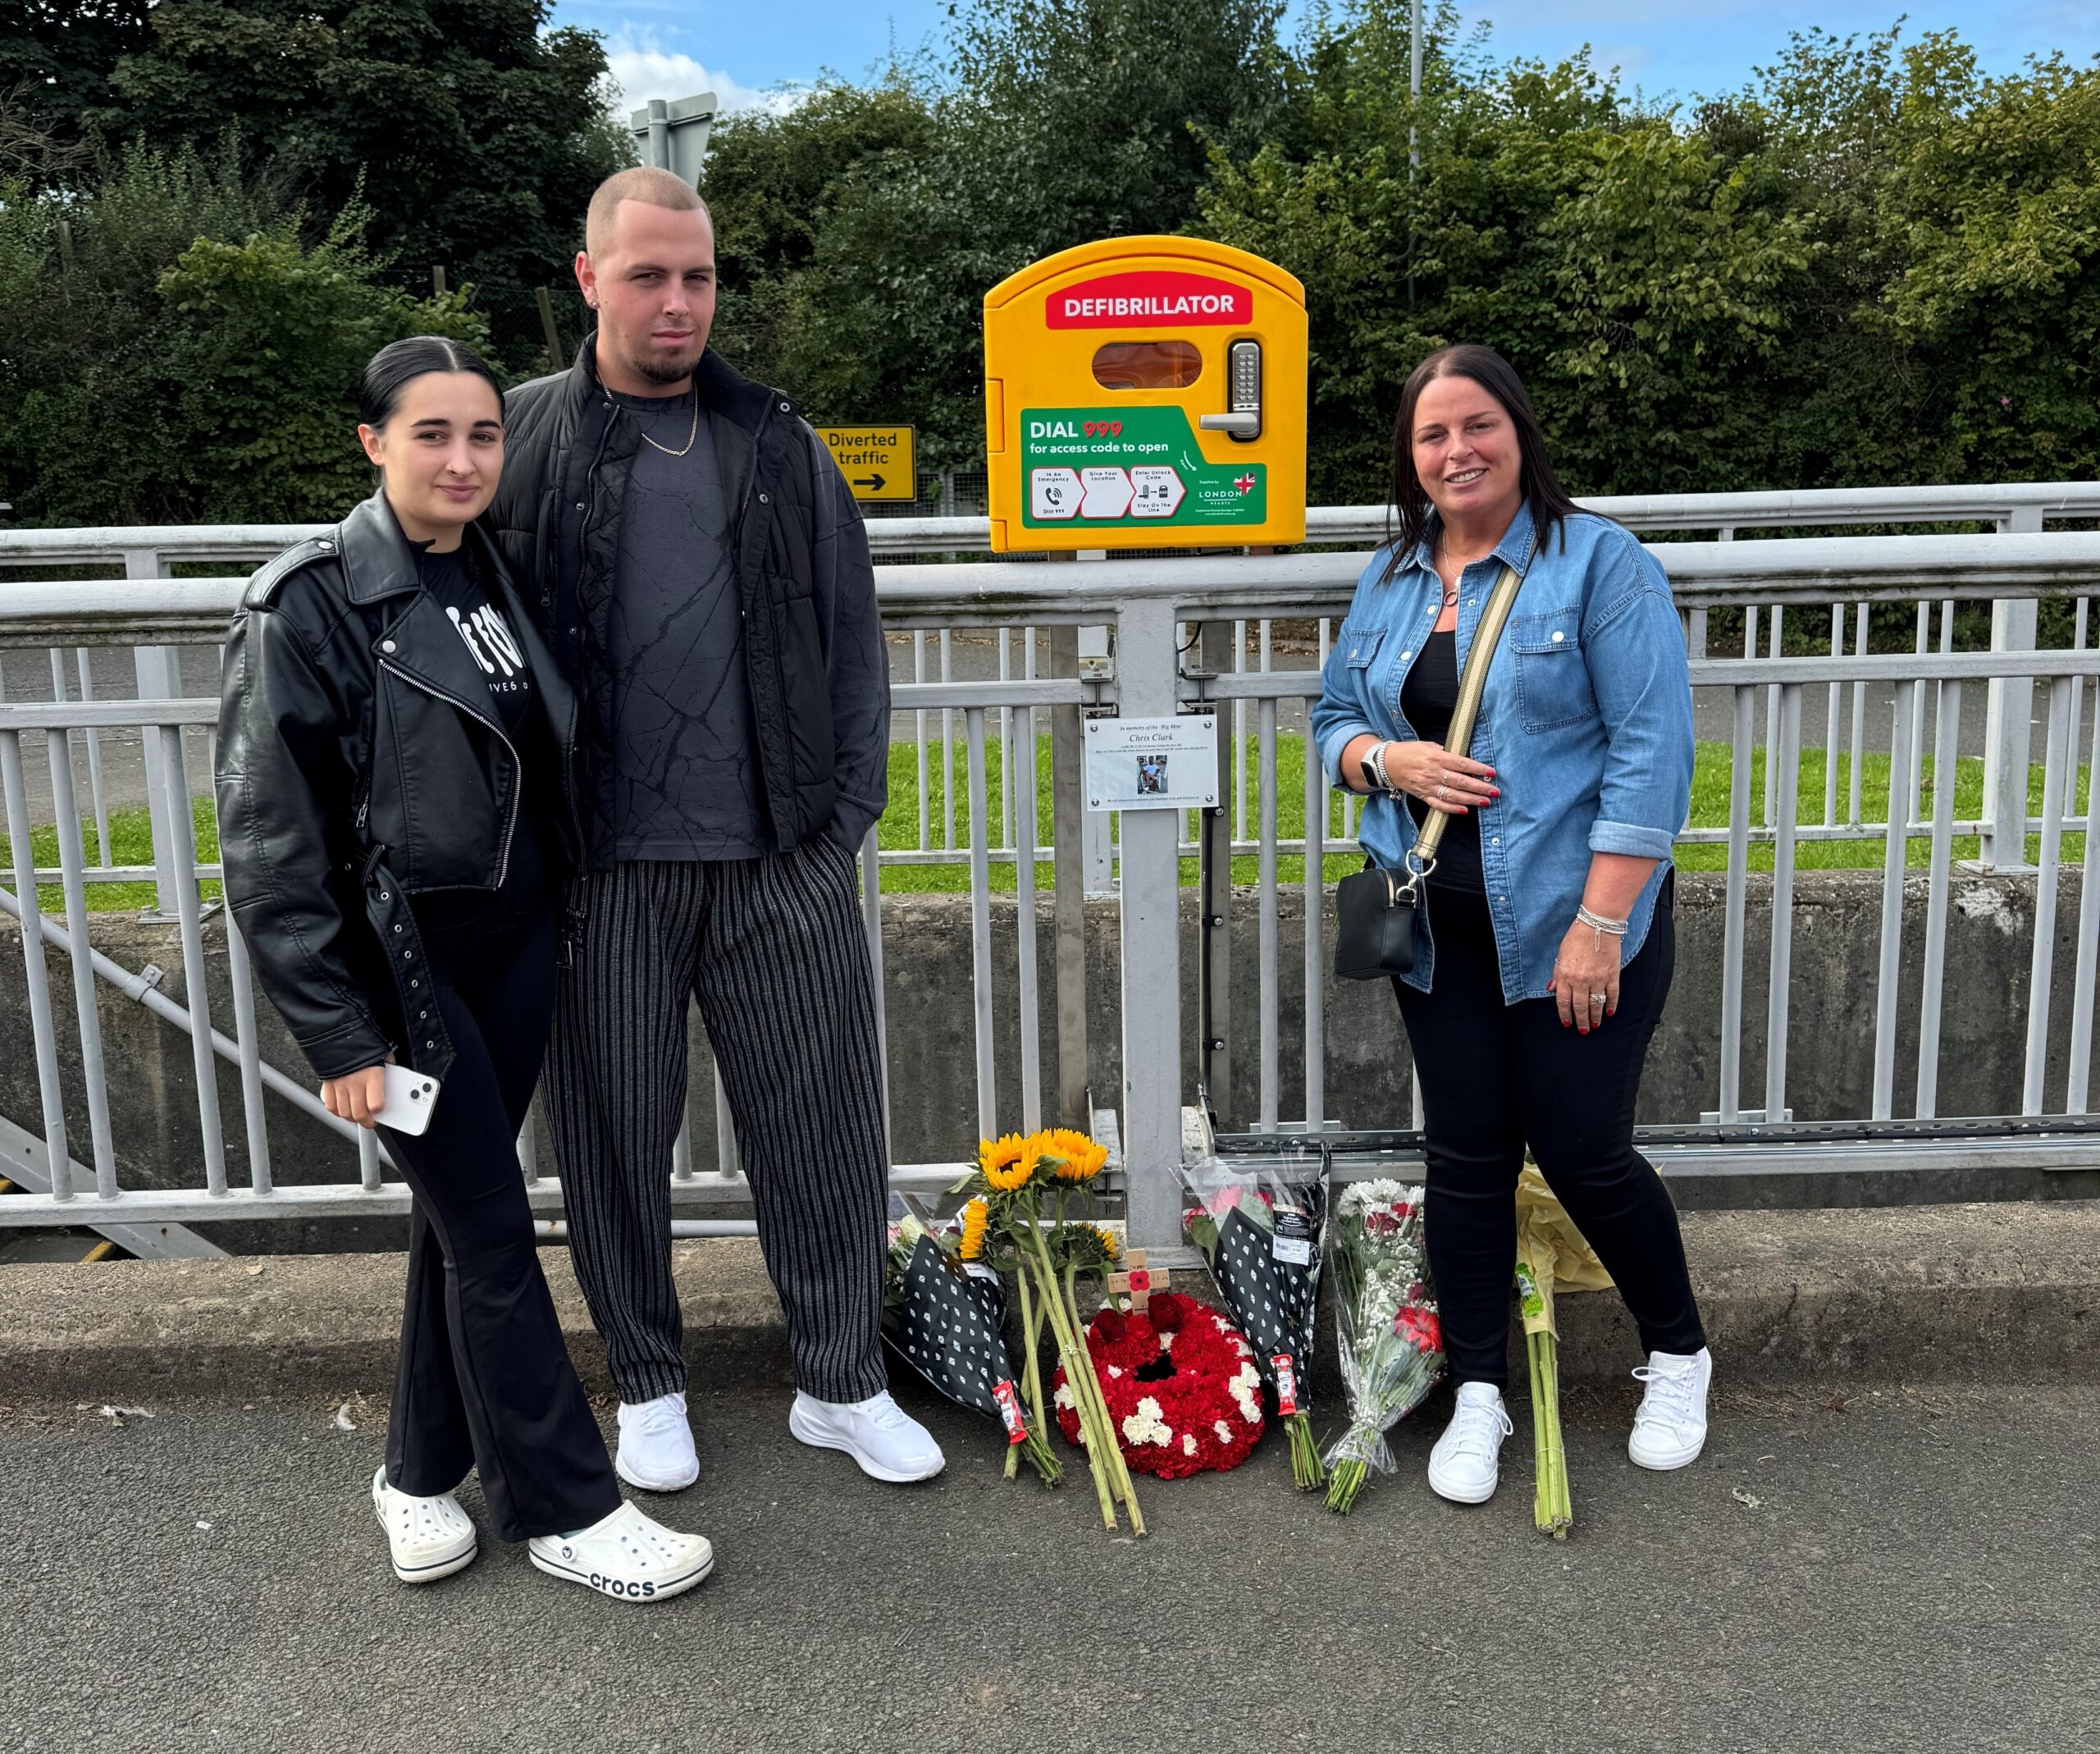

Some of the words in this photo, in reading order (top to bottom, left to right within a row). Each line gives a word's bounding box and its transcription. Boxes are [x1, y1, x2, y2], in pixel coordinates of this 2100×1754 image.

[1065, 295, 1235, 317] DEFIBRILLATOR
[1030, 421, 1079, 438] DIAL
[1083, 420, 1122, 438] 999
[829, 432, 897, 446] Diverted
[1029, 443, 1048, 454] for
[1050, 445, 1088, 454] access
[1090, 441, 1120, 453] code
[1122, 443, 1135, 452] to
[1138, 444, 1169, 454] open
[838, 451, 889, 464] traffic
[1129, 733, 1150, 742] Chris
[1152, 733, 1173, 742] Clark
[589, 1573, 655, 1596] crocs
